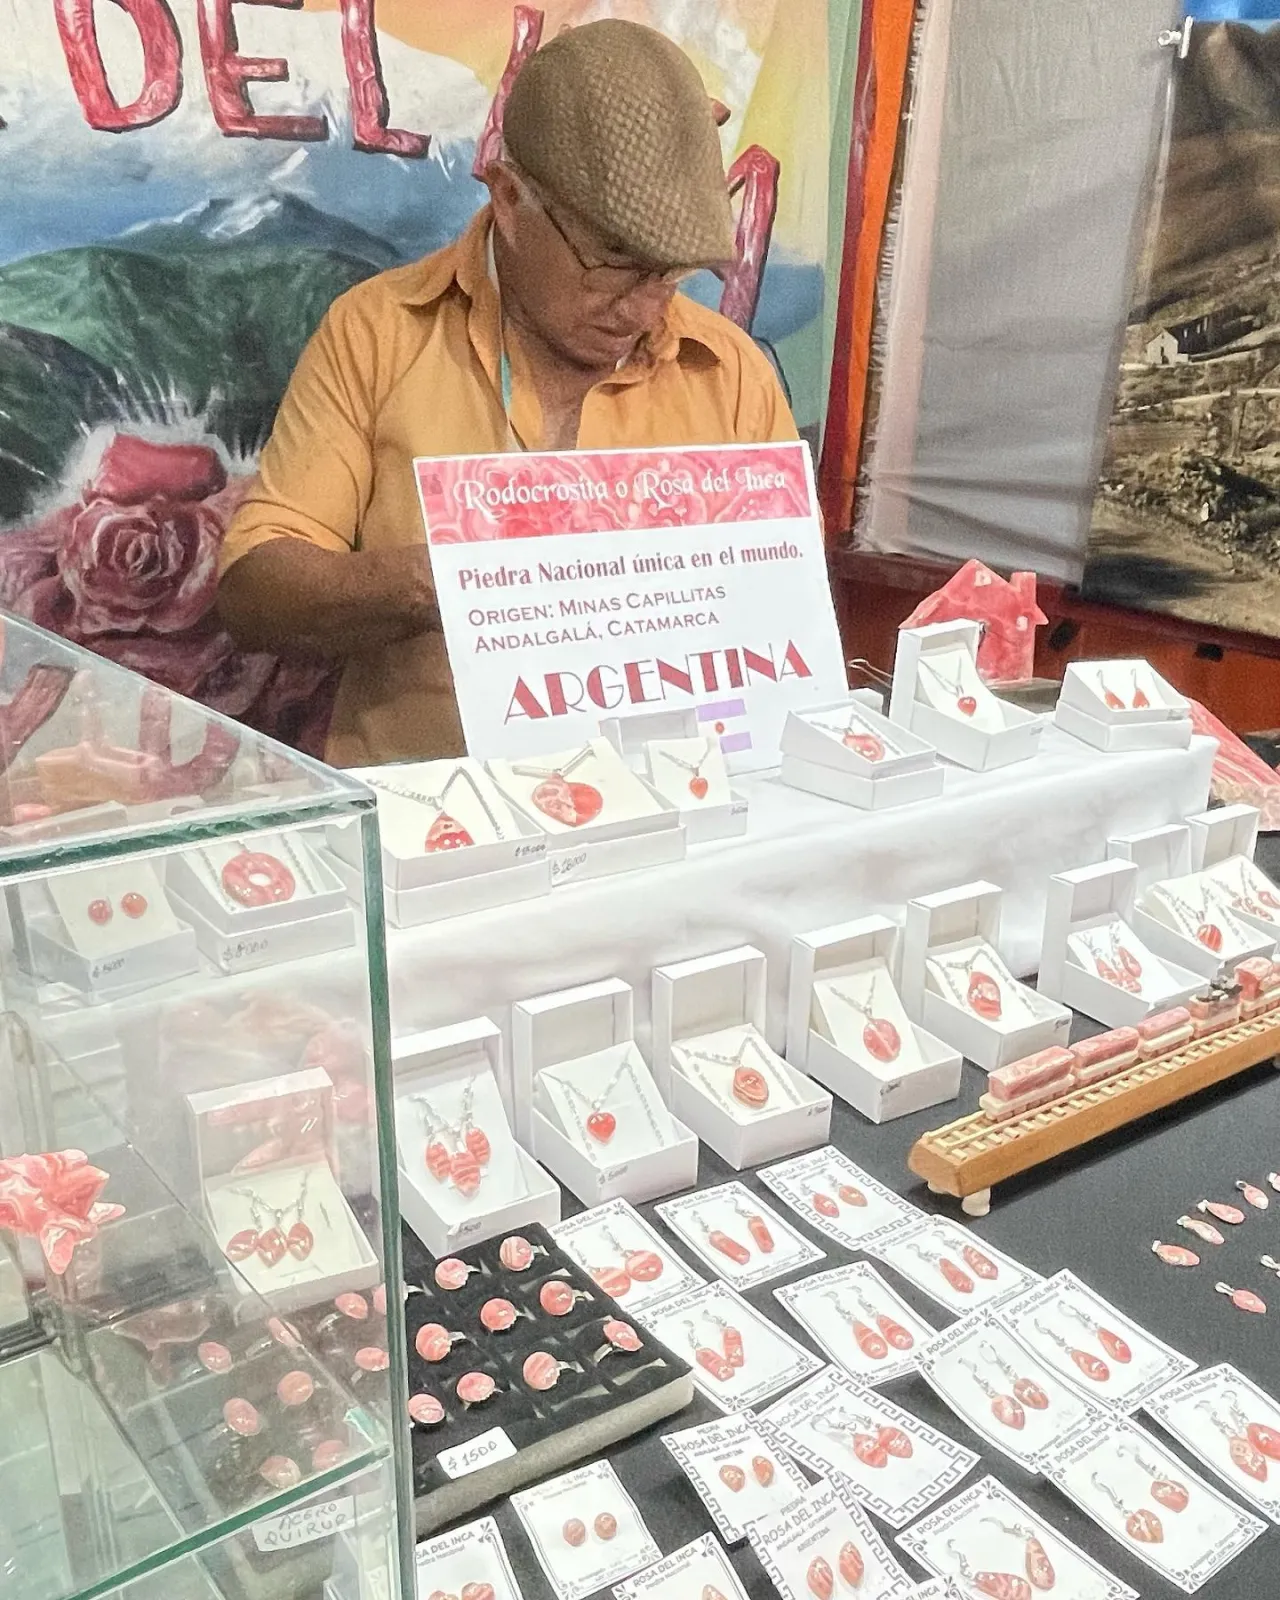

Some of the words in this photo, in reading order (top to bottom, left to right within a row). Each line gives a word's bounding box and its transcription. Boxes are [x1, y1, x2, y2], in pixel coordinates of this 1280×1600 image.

[56, 0, 432, 158] DEL
[454, 470, 608, 520] Rodocrosita
[615, 481, 628, 499] o
[633, 470, 695, 509] Rosa
[701, 467, 730, 493] del
[734, 466, 786, 491] Inca
[458, 567, 531, 591] Piedra
[538, 557, 627, 582] Nacional
[633, 553, 687, 575] única
[691, 552, 713, 570] en
[719, 546, 735, 565] el
[740, 541, 804, 562] mundo.
[468, 604, 555, 627] ORIGEN:
[558, 596, 622, 618] MINAS
[626, 585, 727, 609] CAPILLITAS
[475, 621, 603, 653] ANDALGALÁ,
[608, 610, 720, 637] CATAMARCA
[504, 639, 812, 726] ARGENTINA
[461, 1440, 498, 1467] 1500
[762, 1519, 793, 1546] ROSA
[791, 1507, 813, 1527] DEL
[810, 1489, 839, 1513] INCA
[916, 1514, 945, 1535] ROSA
[941, 1502, 963, 1518] DEL
[959, 1487, 984, 1506] INCA
[430, 1540, 451, 1554] DEL
[450, 1530, 475, 1546] INCA
[633, 1569, 658, 1588] ROSA
[656, 1560, 677, 1574] DEL
[674, 1546, 699, 1563] INCA
